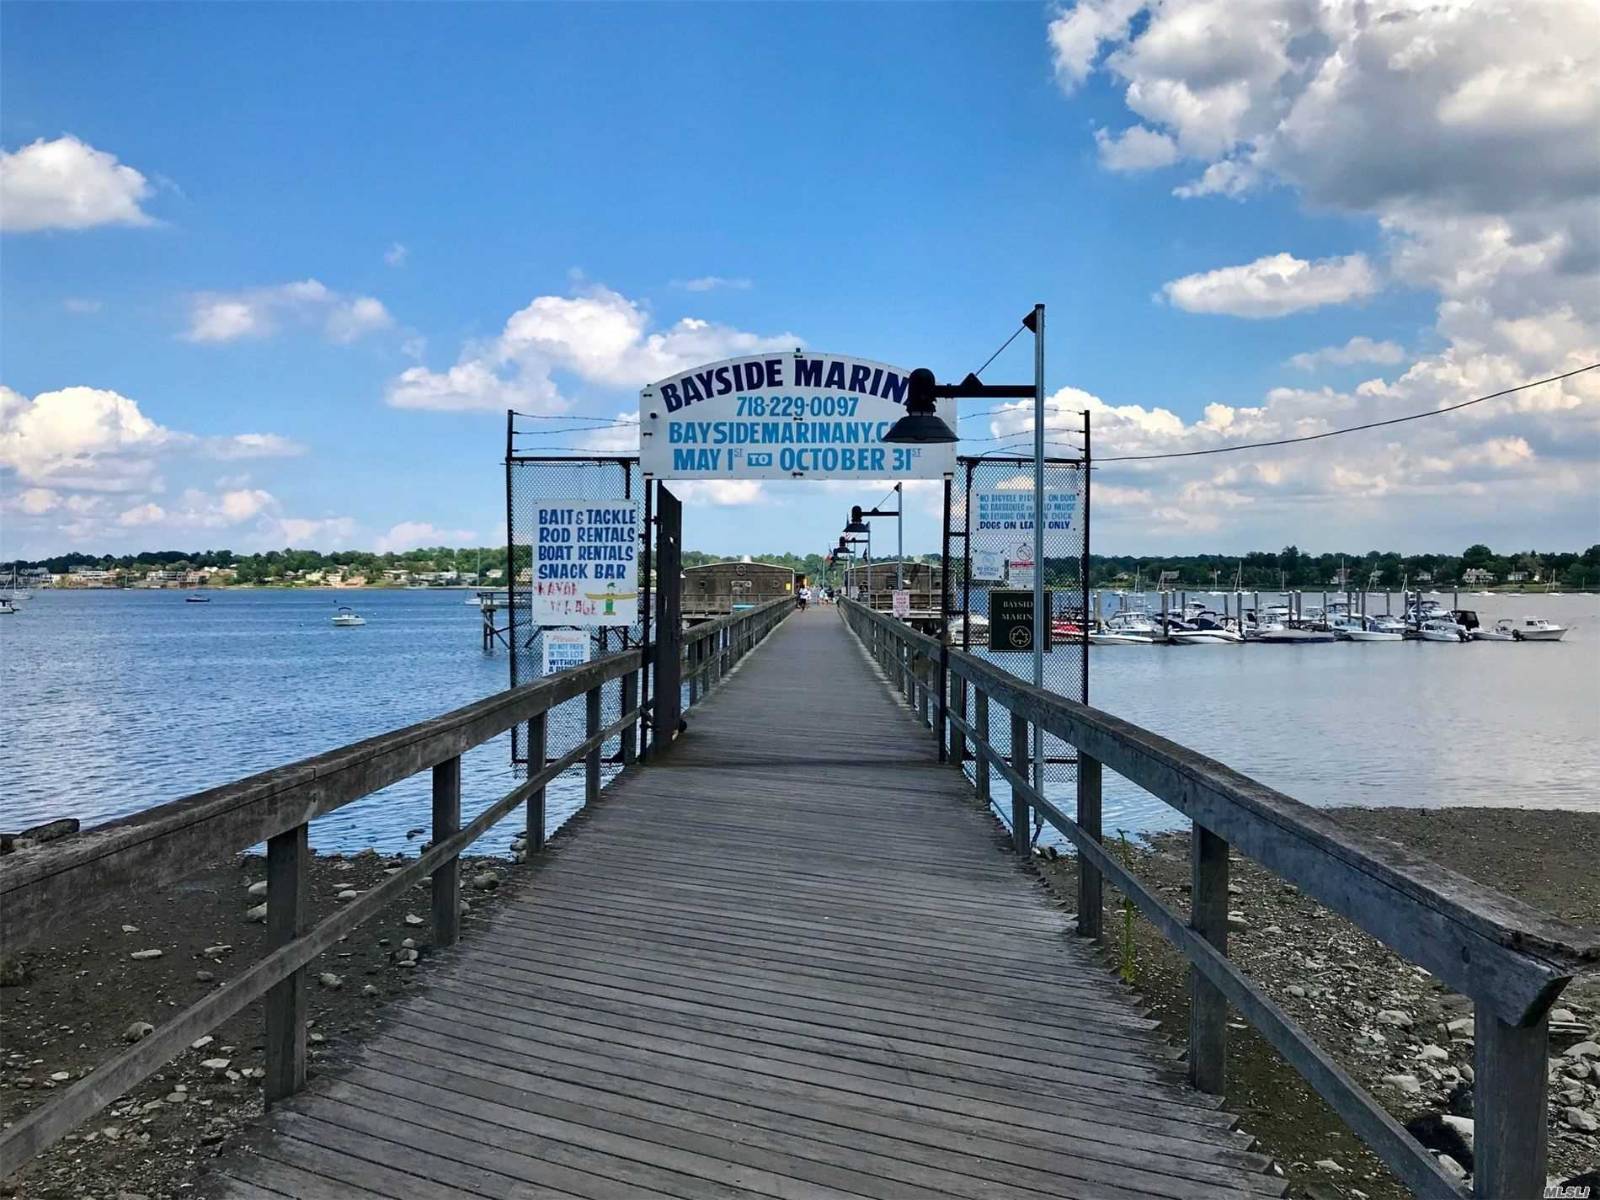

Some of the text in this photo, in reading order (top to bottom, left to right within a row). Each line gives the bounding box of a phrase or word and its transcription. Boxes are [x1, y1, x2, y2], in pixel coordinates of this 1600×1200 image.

[660, 359, 909, 413] BAYSIDE MARIN
[669, 421, 896, 444] BAYSIDEMARINANY.C
[673, 448, 721, 471] MAY
[749, 454, 769, 465] TO
[779, 447, 885, 472] OCTOBER
[980, 494, 989, 502] NO
[980, 503, 989, 511] NO
[538, 509, 636, 525] BAIT & TACKLE
[980, 512, 989, 520] NO
[1016, 512, 1026, 520] ON
[980, 521, 1071, 530] DOGS ON LEA ONLY
[539, 527, 635, 543] ROD RENTALS
[538, 545, 634, 561] BOAT RENTALS
[538, 563, 626, 579] SNACK BAR
[1003, 600, 1034, 608] BAYSID
